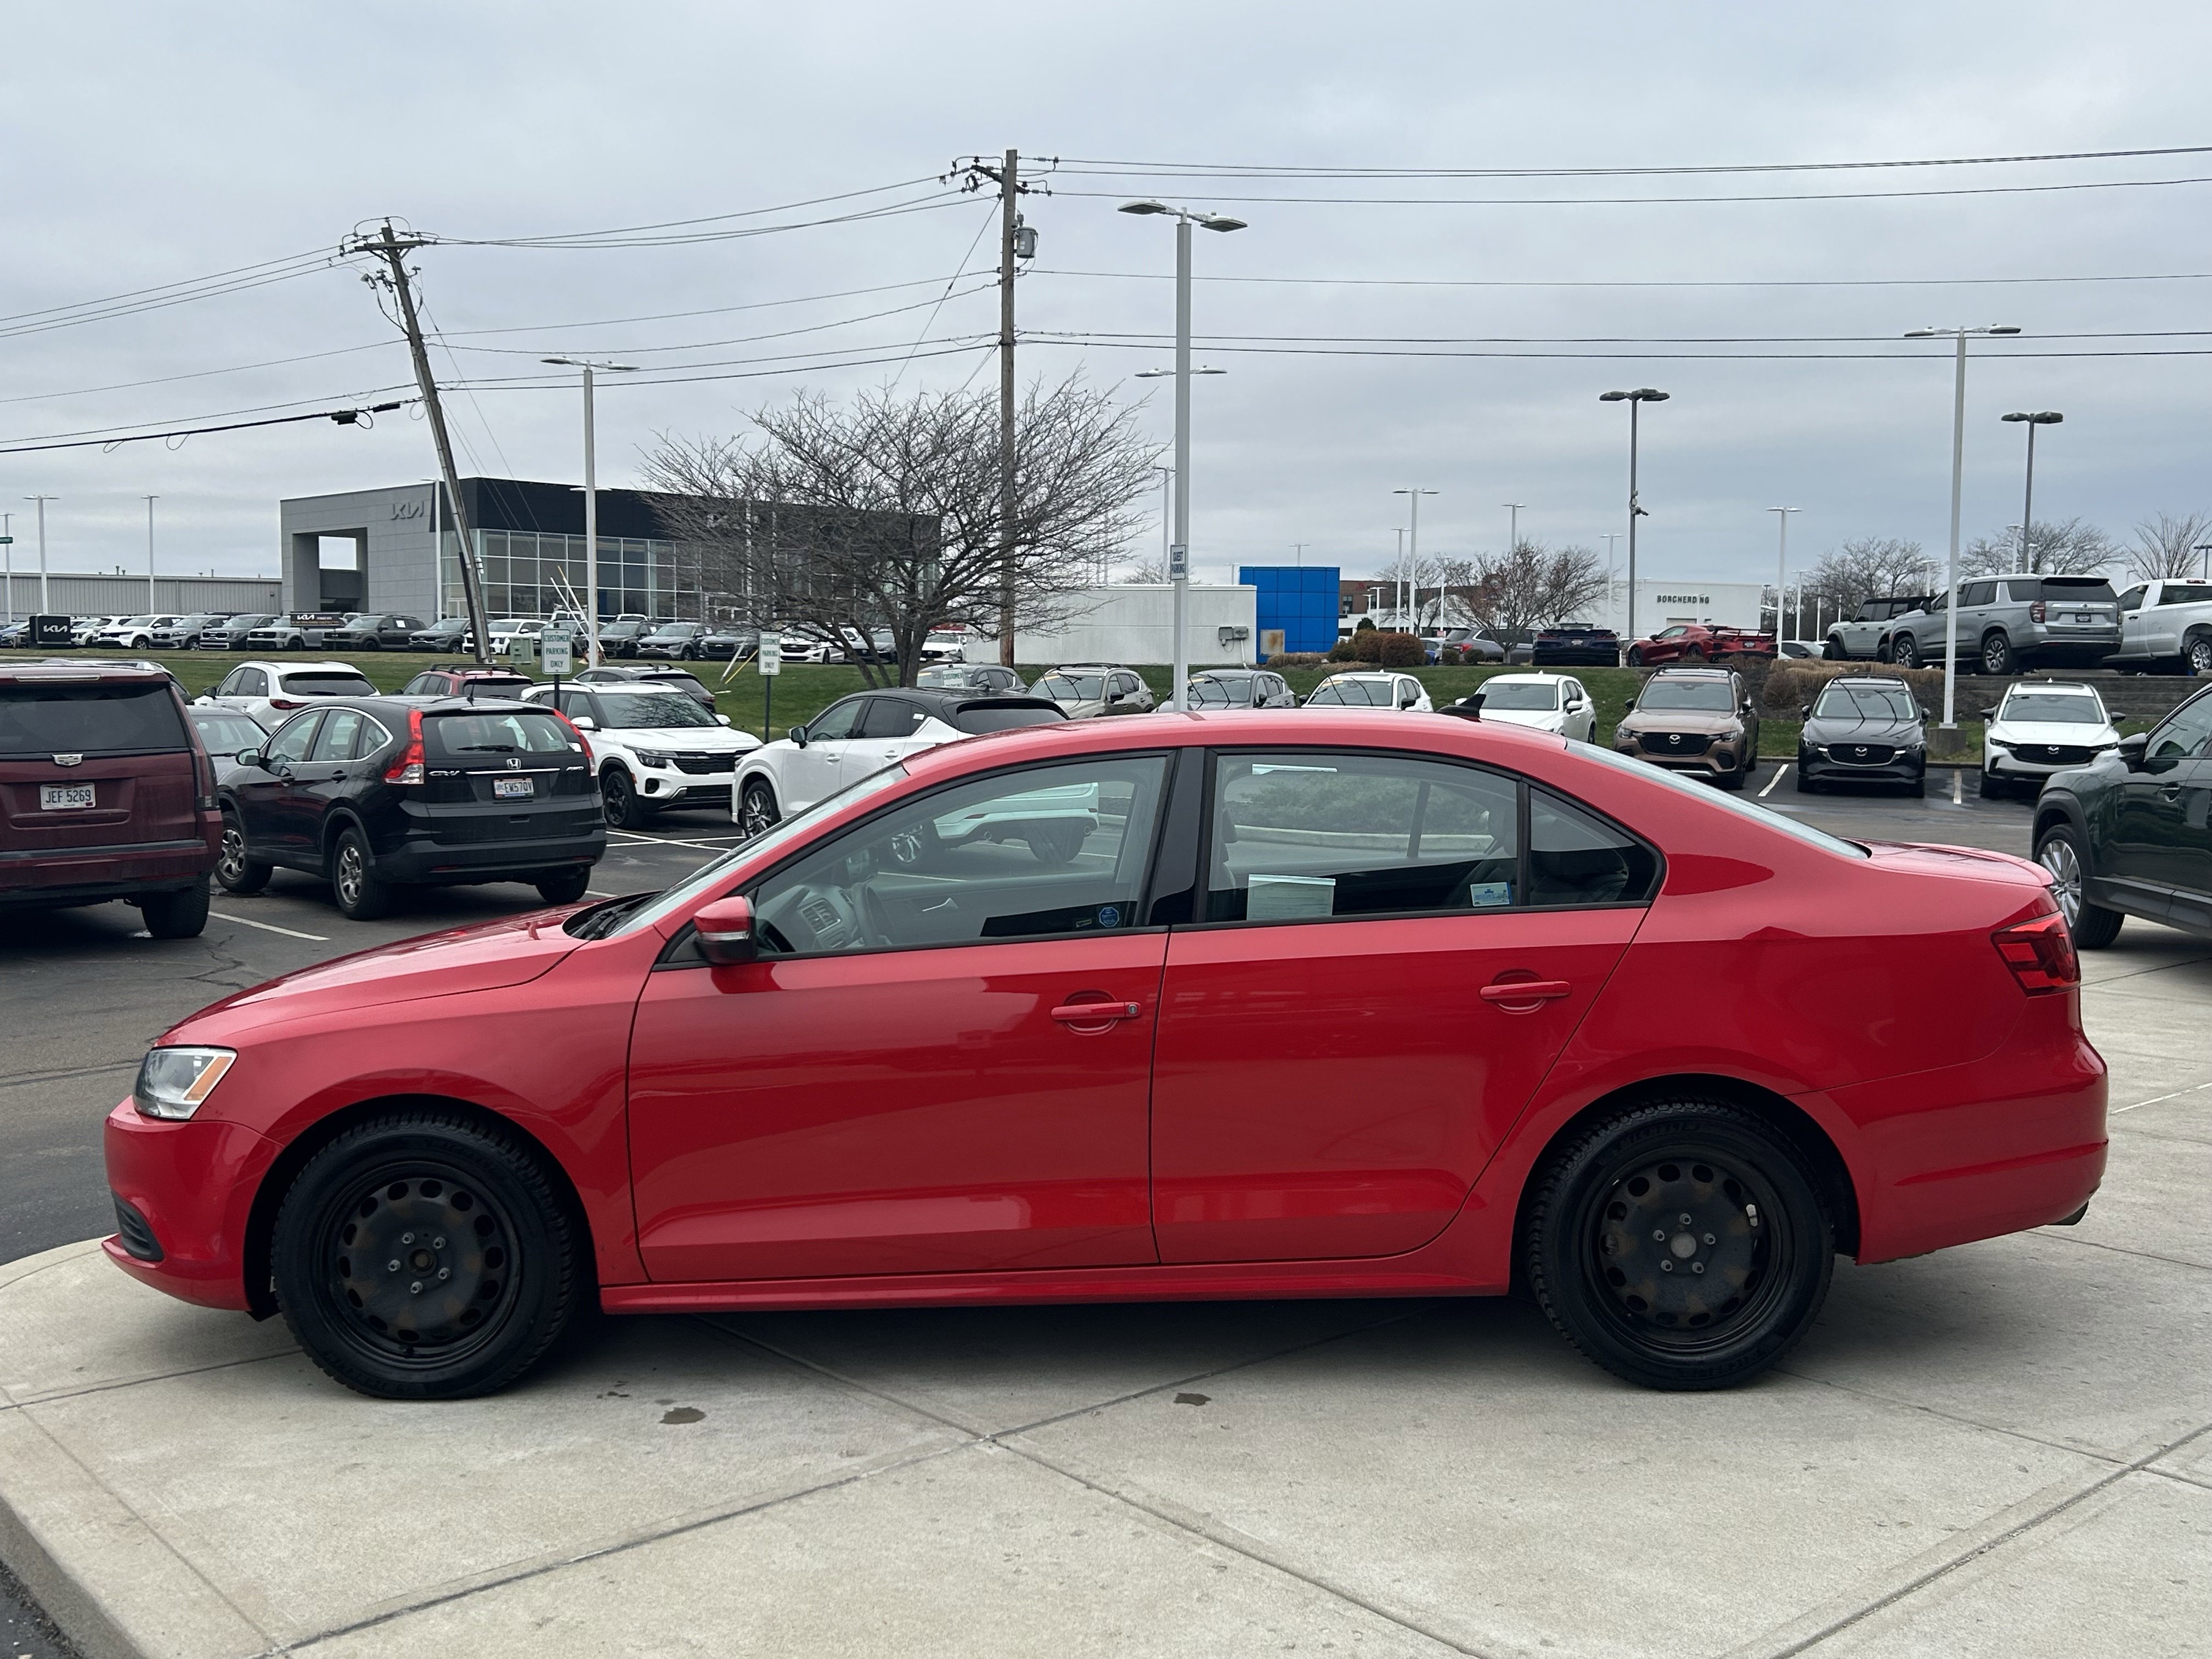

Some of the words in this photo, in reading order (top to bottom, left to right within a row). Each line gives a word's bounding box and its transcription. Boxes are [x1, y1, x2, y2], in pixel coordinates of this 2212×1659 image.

[1657, 595, 1709, 604] BORCHERDNG
[46, 791, 63, 803] JEF
[66, 789, 91, 802] 5269
